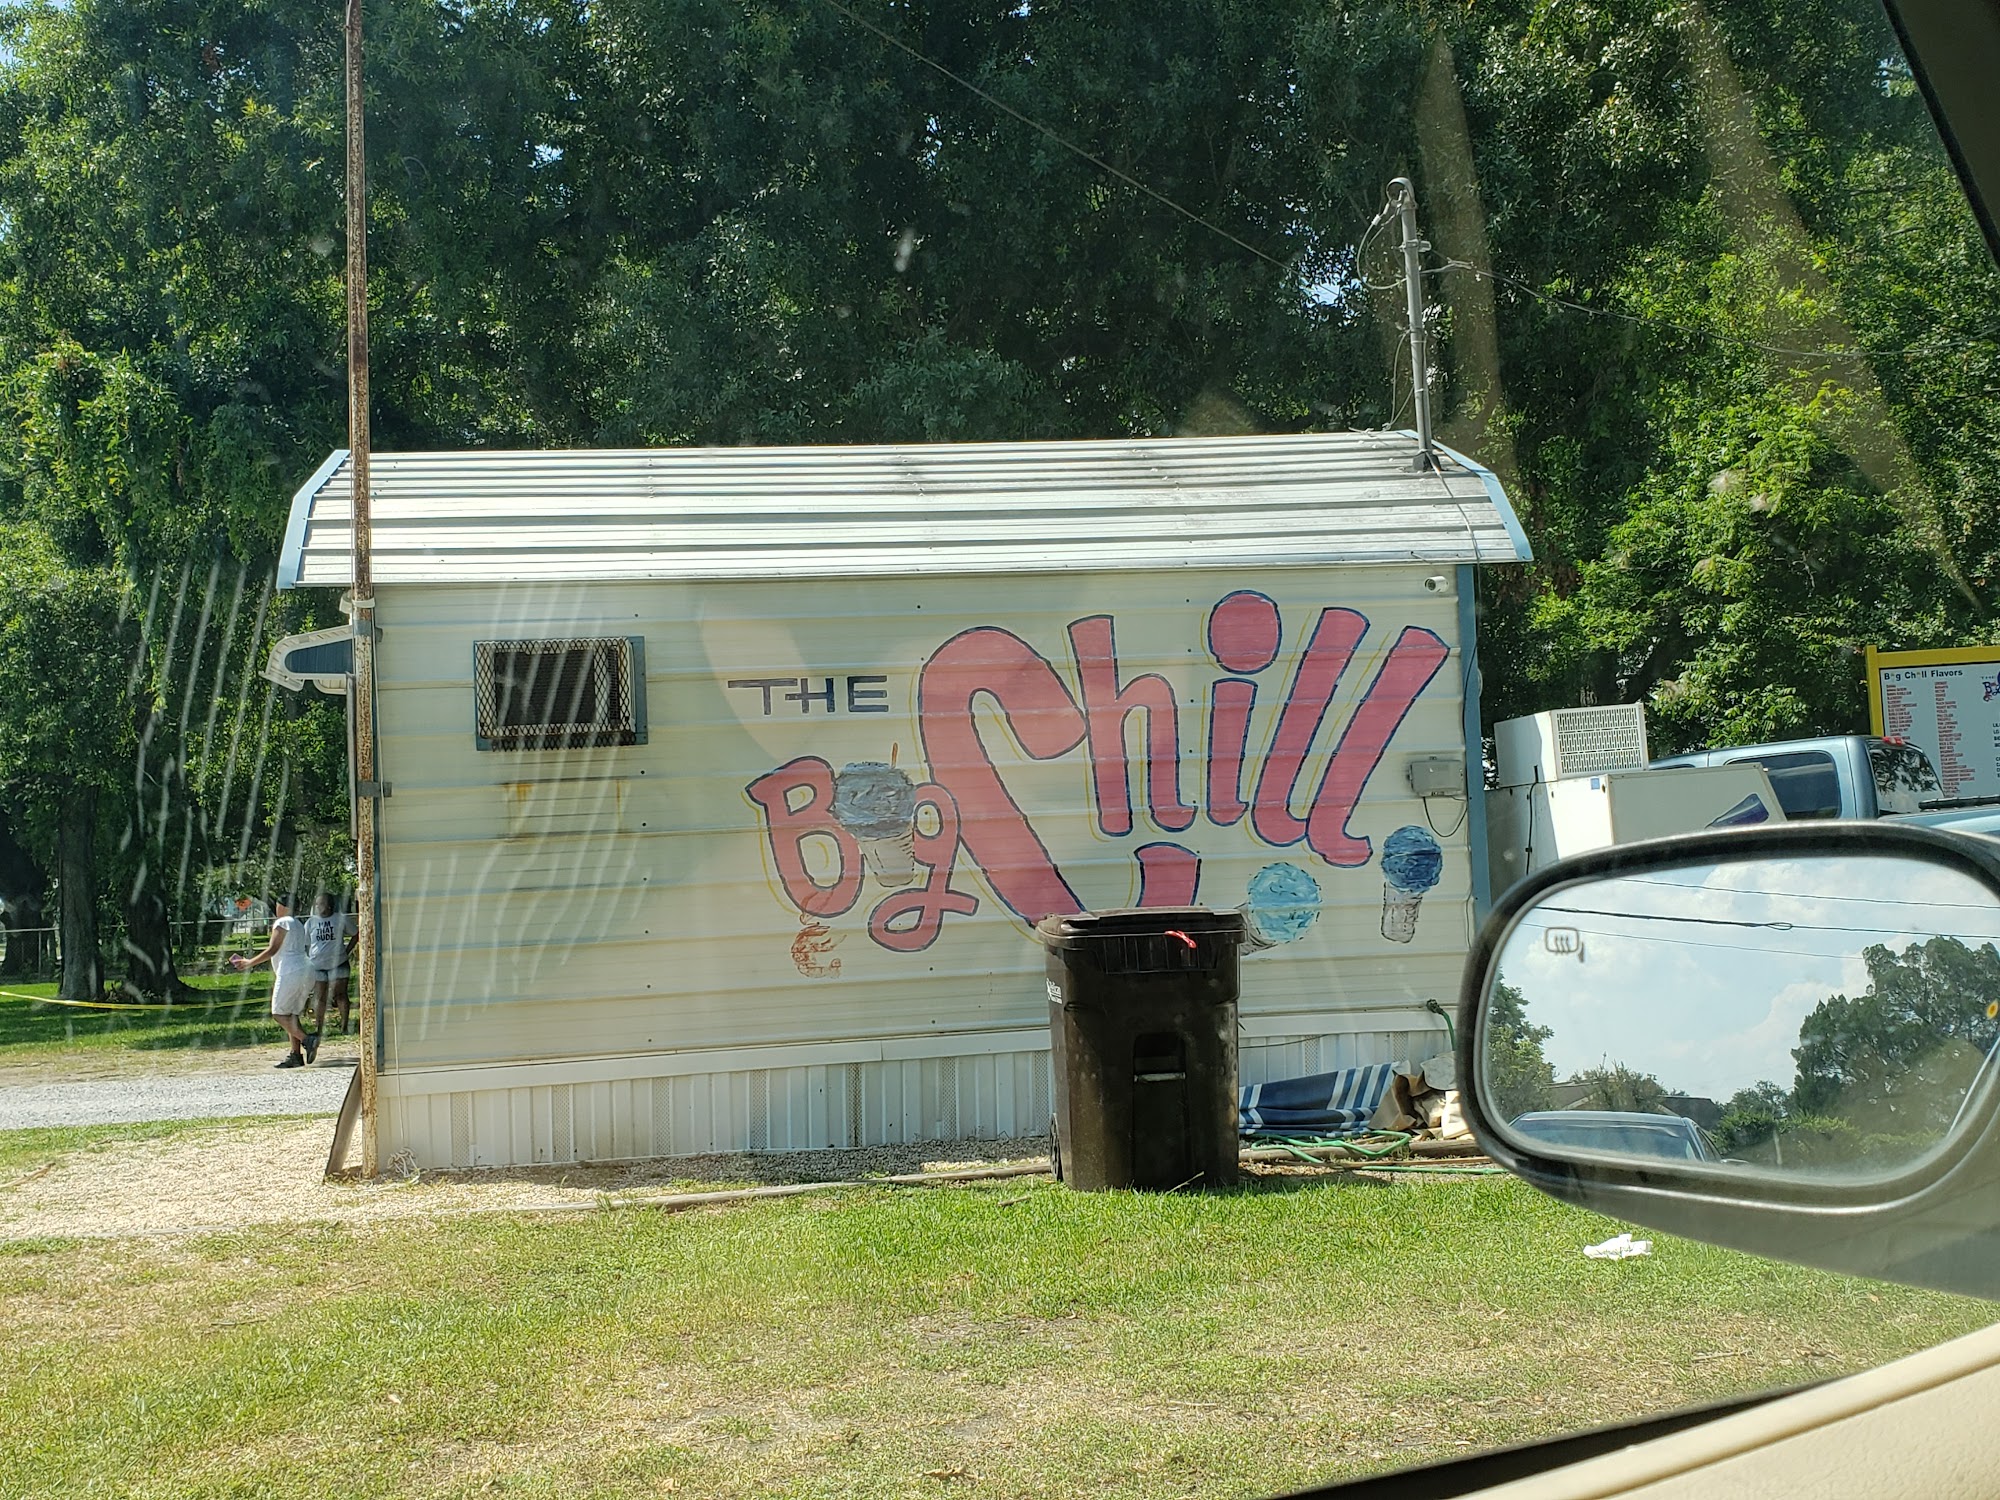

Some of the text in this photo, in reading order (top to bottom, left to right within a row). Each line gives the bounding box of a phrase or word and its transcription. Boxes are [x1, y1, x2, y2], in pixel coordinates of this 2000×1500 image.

[1930, 669, 1963, 678] Flavors
[728, 675, 889, 714] THE
[918, 589, 1450, 928] Chill
[316, 927, 334, 935] THAT
